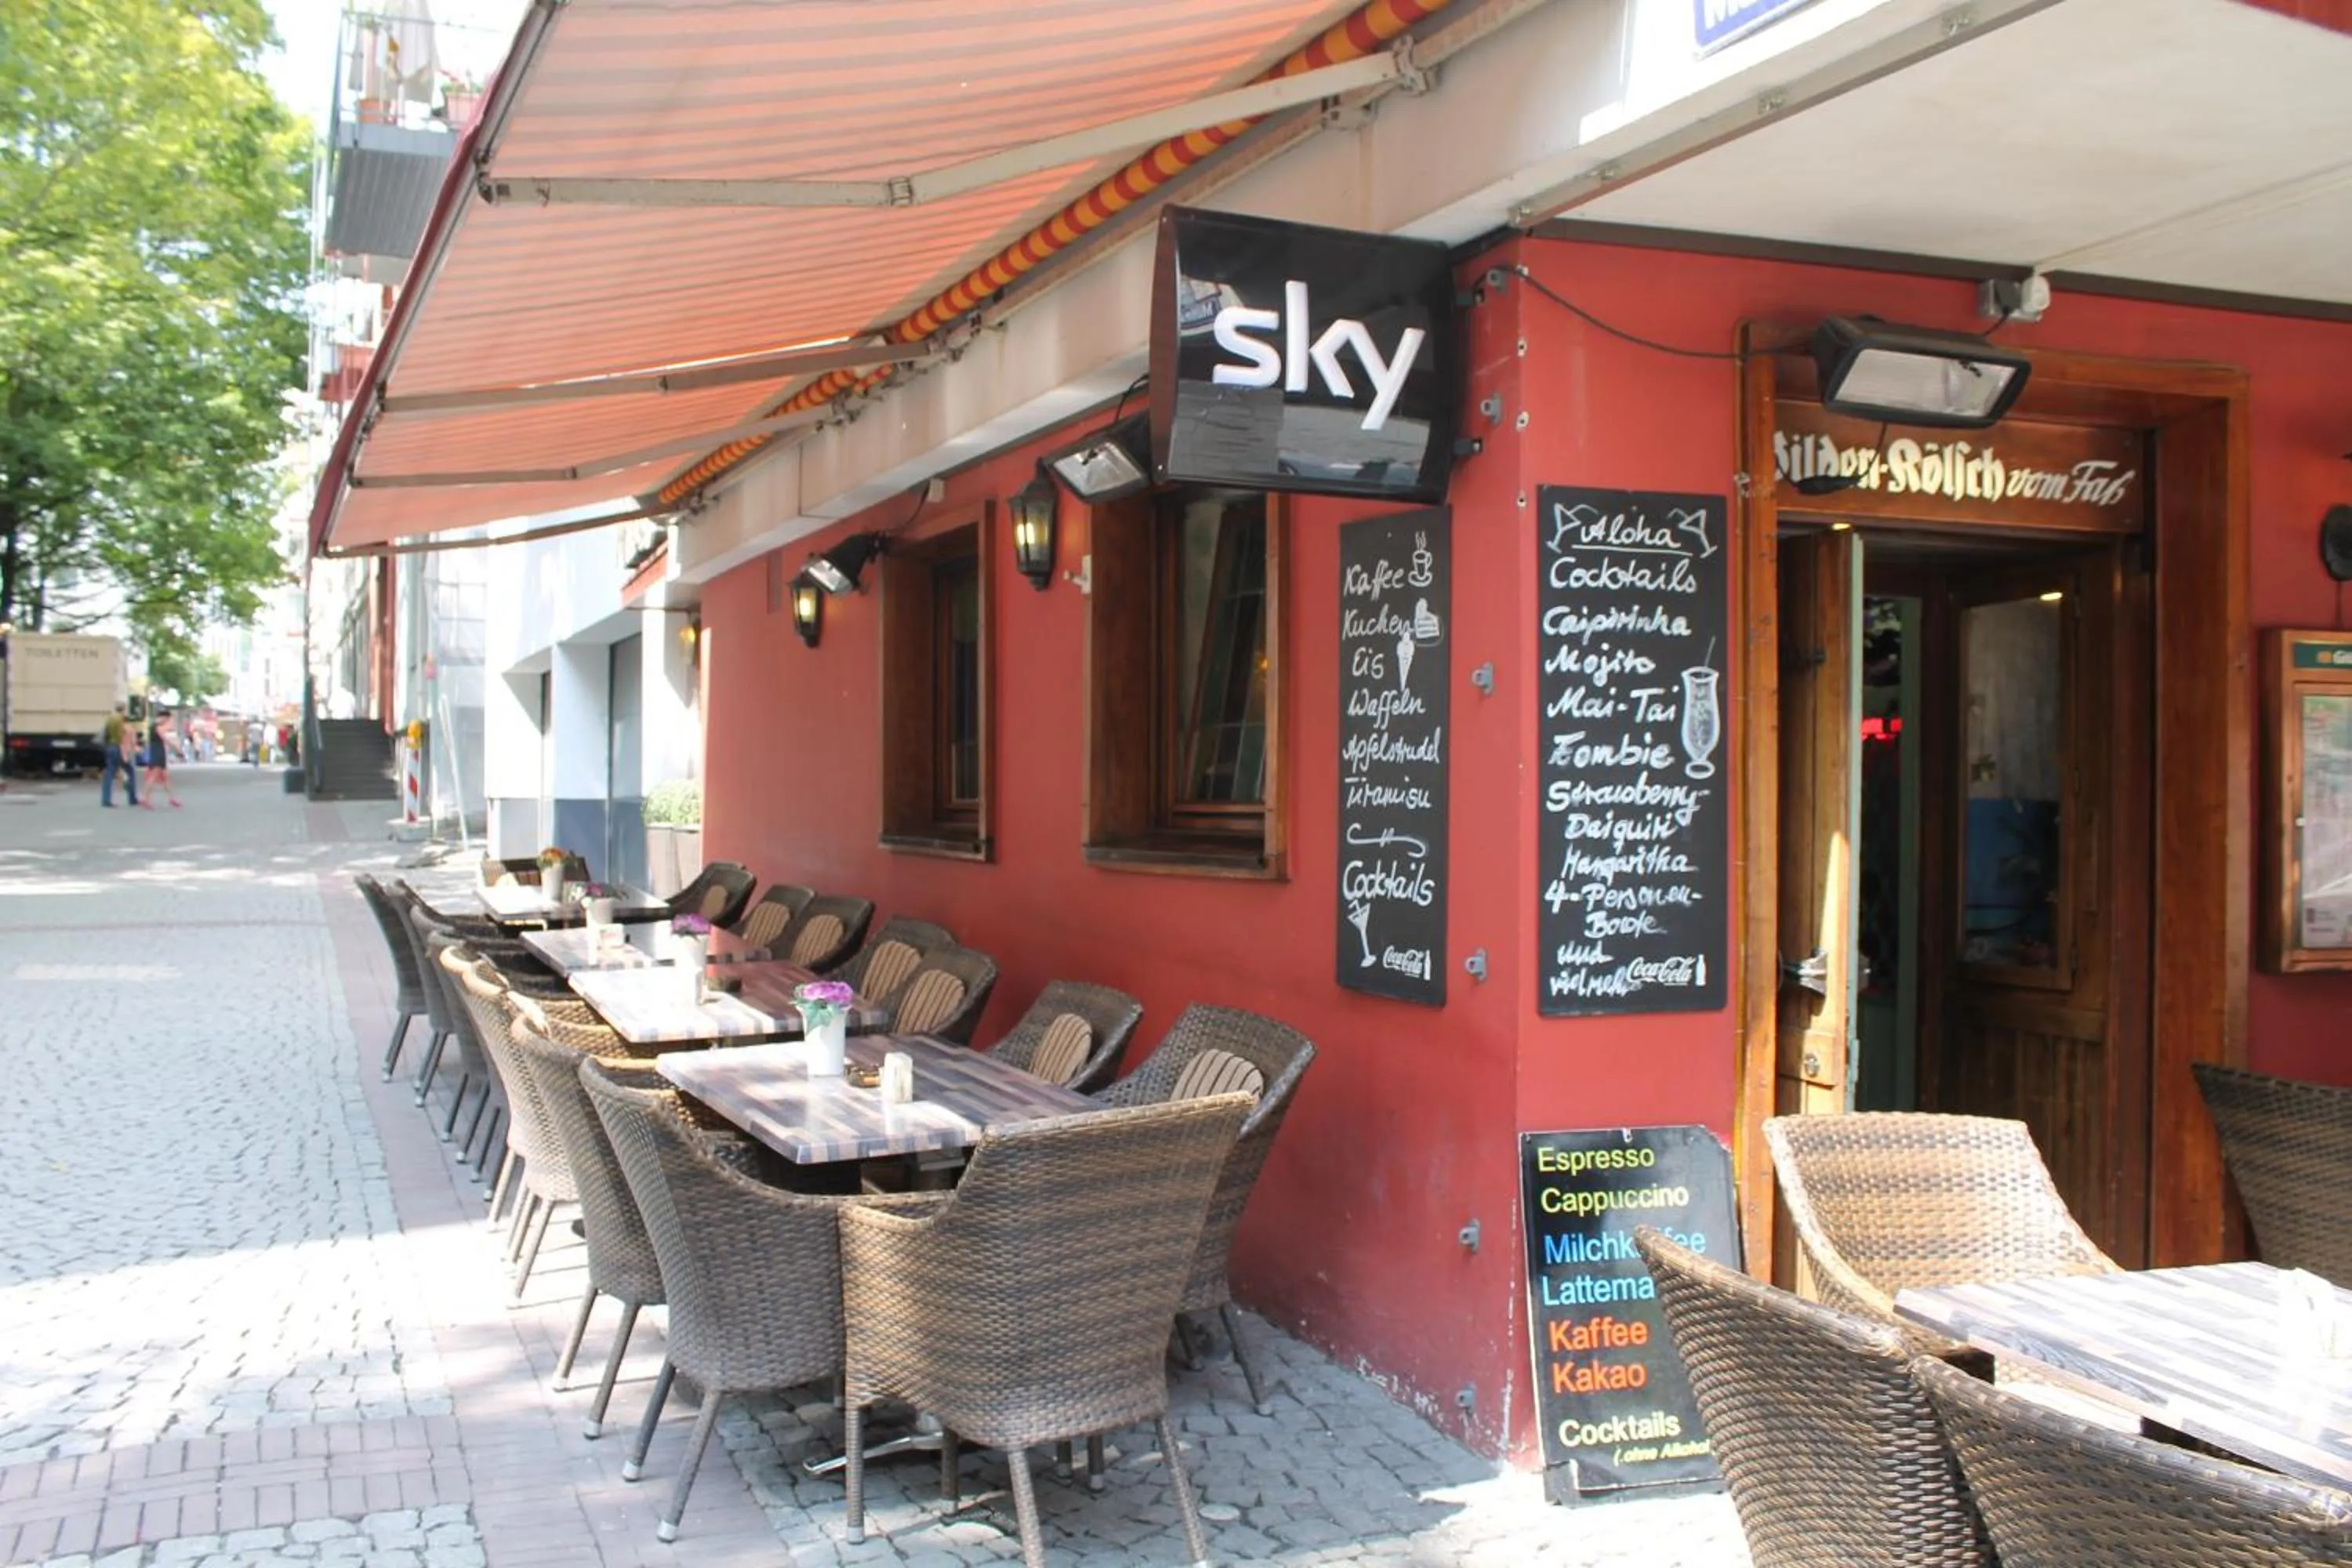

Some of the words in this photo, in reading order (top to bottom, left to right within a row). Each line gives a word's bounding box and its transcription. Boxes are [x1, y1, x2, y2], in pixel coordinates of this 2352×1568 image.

[1212, 279, 1426, 430] sky
[2005, 466, 2065, 499] vom
[1580, 514, 1682, 549] Aloha
[1343, 559, 1406, 602] Kaffee
[1549, 557, 1697, 593] Cocktails
[1341, 603, 1415, 641] Kuchen
[1542, 604, 1693, 645] Caipirinha
[1352, 646, 1385, 680] Eis
[1544, 643, 1657, 688] Mojito
[1347, 688, 1426, 730] Waffeln
[1342, 725, 1441, 774] Apfelstrudel
[1547, 730, 1675, 770] Zombie
[1345, 775, 1432, 809] Tiramisu
[1564, 809, 1678, 855] Daiquiri
[1342, 859, 1436, 907] Cocktails
[1557, 940, 1615, 966] und
[1537, 1145, 1655, 1176] Espresso
[1541, 1184, 1690, 1218] Cappuccino
[1544, 1225, 1707, 1265] Milchkee
[1548, 1318, 1649, 1355] Kaffee
[1552, 1359, 1647, 1395] Kakao
[1559, 1410, 1681, 1448] Cocktails
